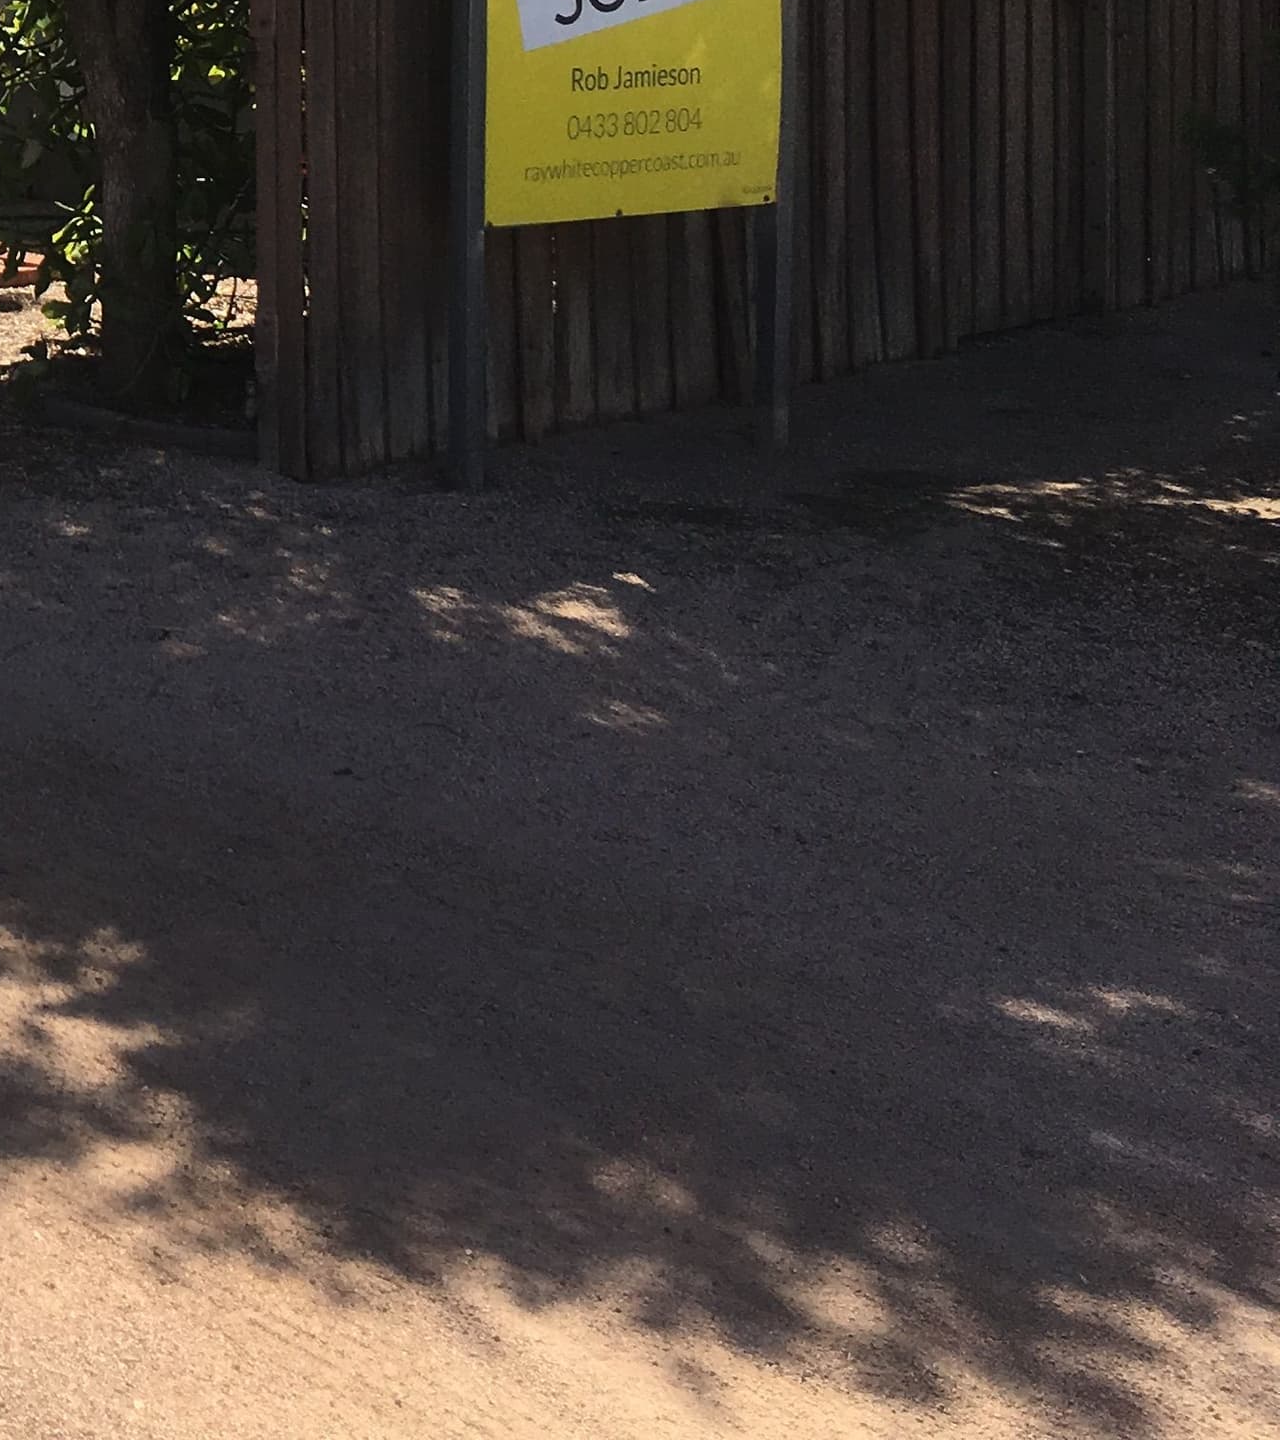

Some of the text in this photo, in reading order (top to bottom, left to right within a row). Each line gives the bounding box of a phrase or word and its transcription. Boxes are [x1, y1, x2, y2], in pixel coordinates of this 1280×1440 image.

[571, 63, 701, 92] Rob Jamieson
[567, 107, 703, 141] 0433 802 804
[524, 150, 740, 183] raywhitecoppercoast.com.au
